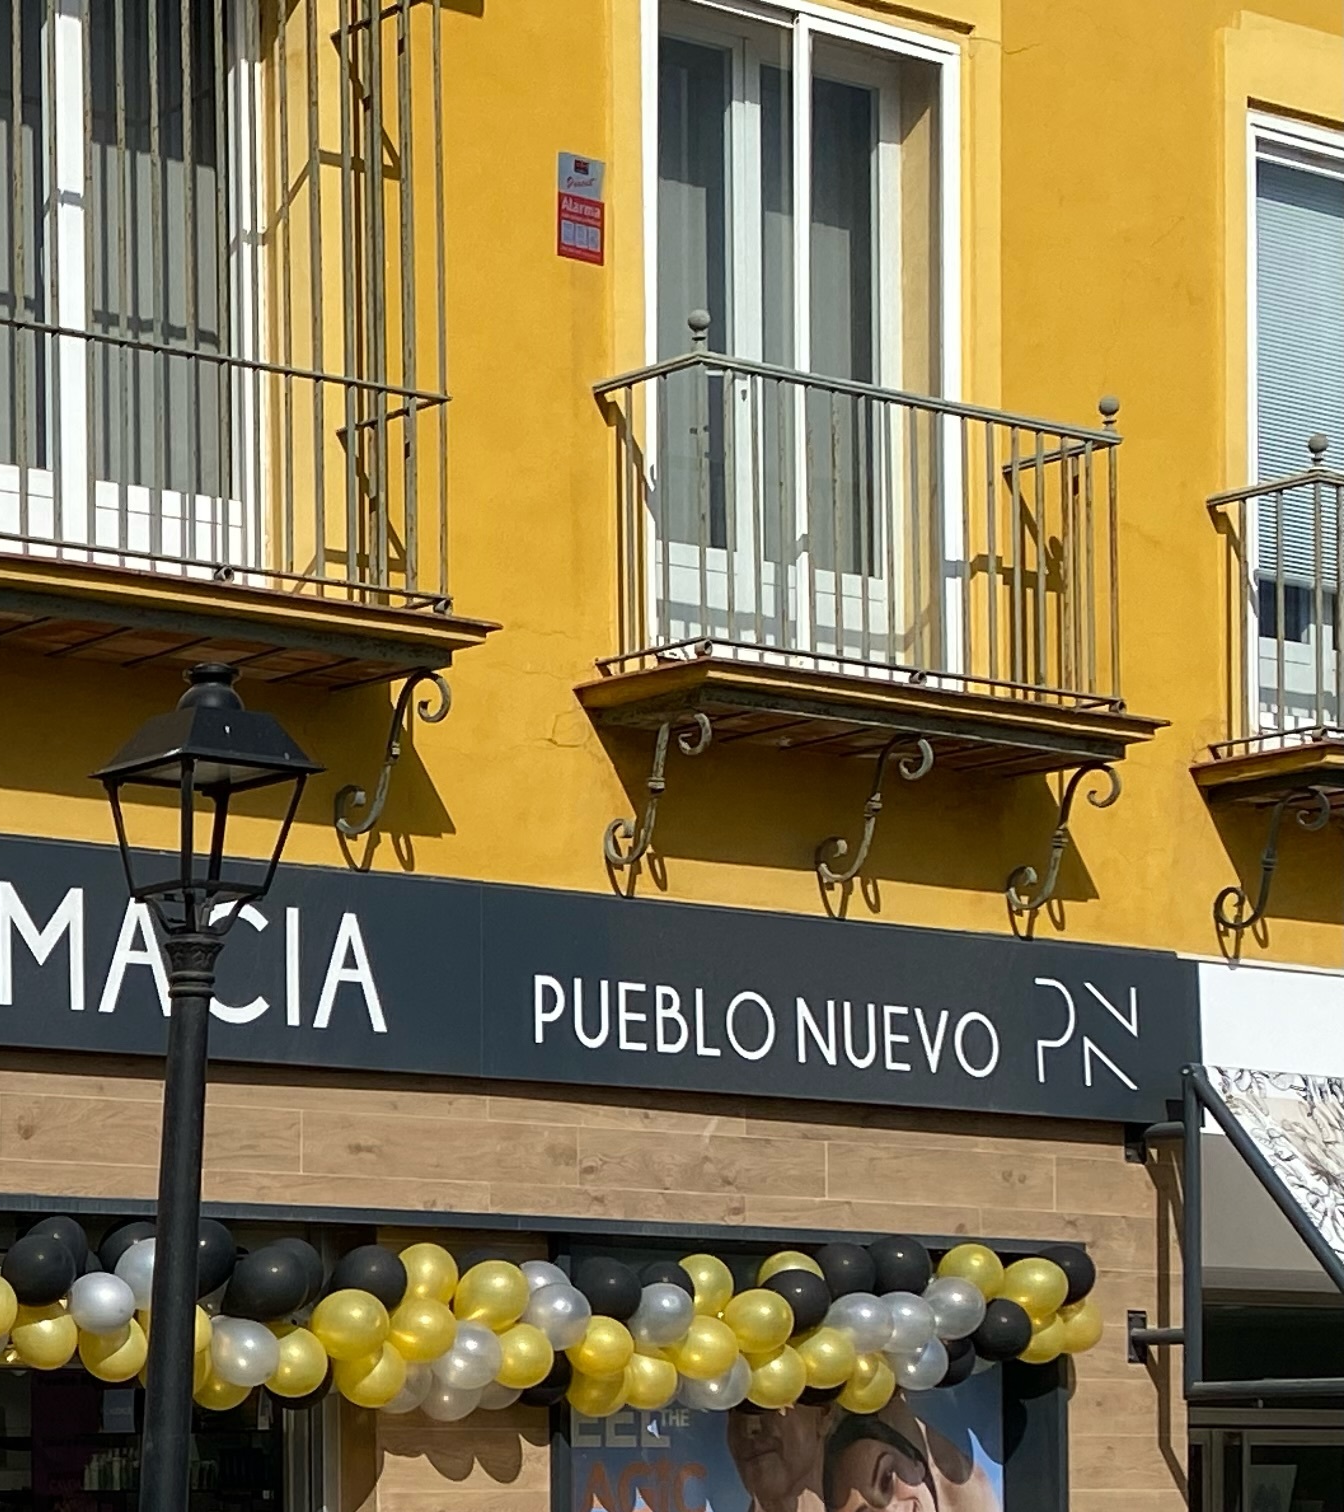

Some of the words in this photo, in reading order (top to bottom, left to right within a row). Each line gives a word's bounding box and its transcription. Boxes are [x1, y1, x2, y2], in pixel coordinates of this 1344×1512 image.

[534, 974, 776, 1061] PUEBLO
[796, 998, 1000, 1079] NUEVO
[662, 1408, 691, 1427] THE
